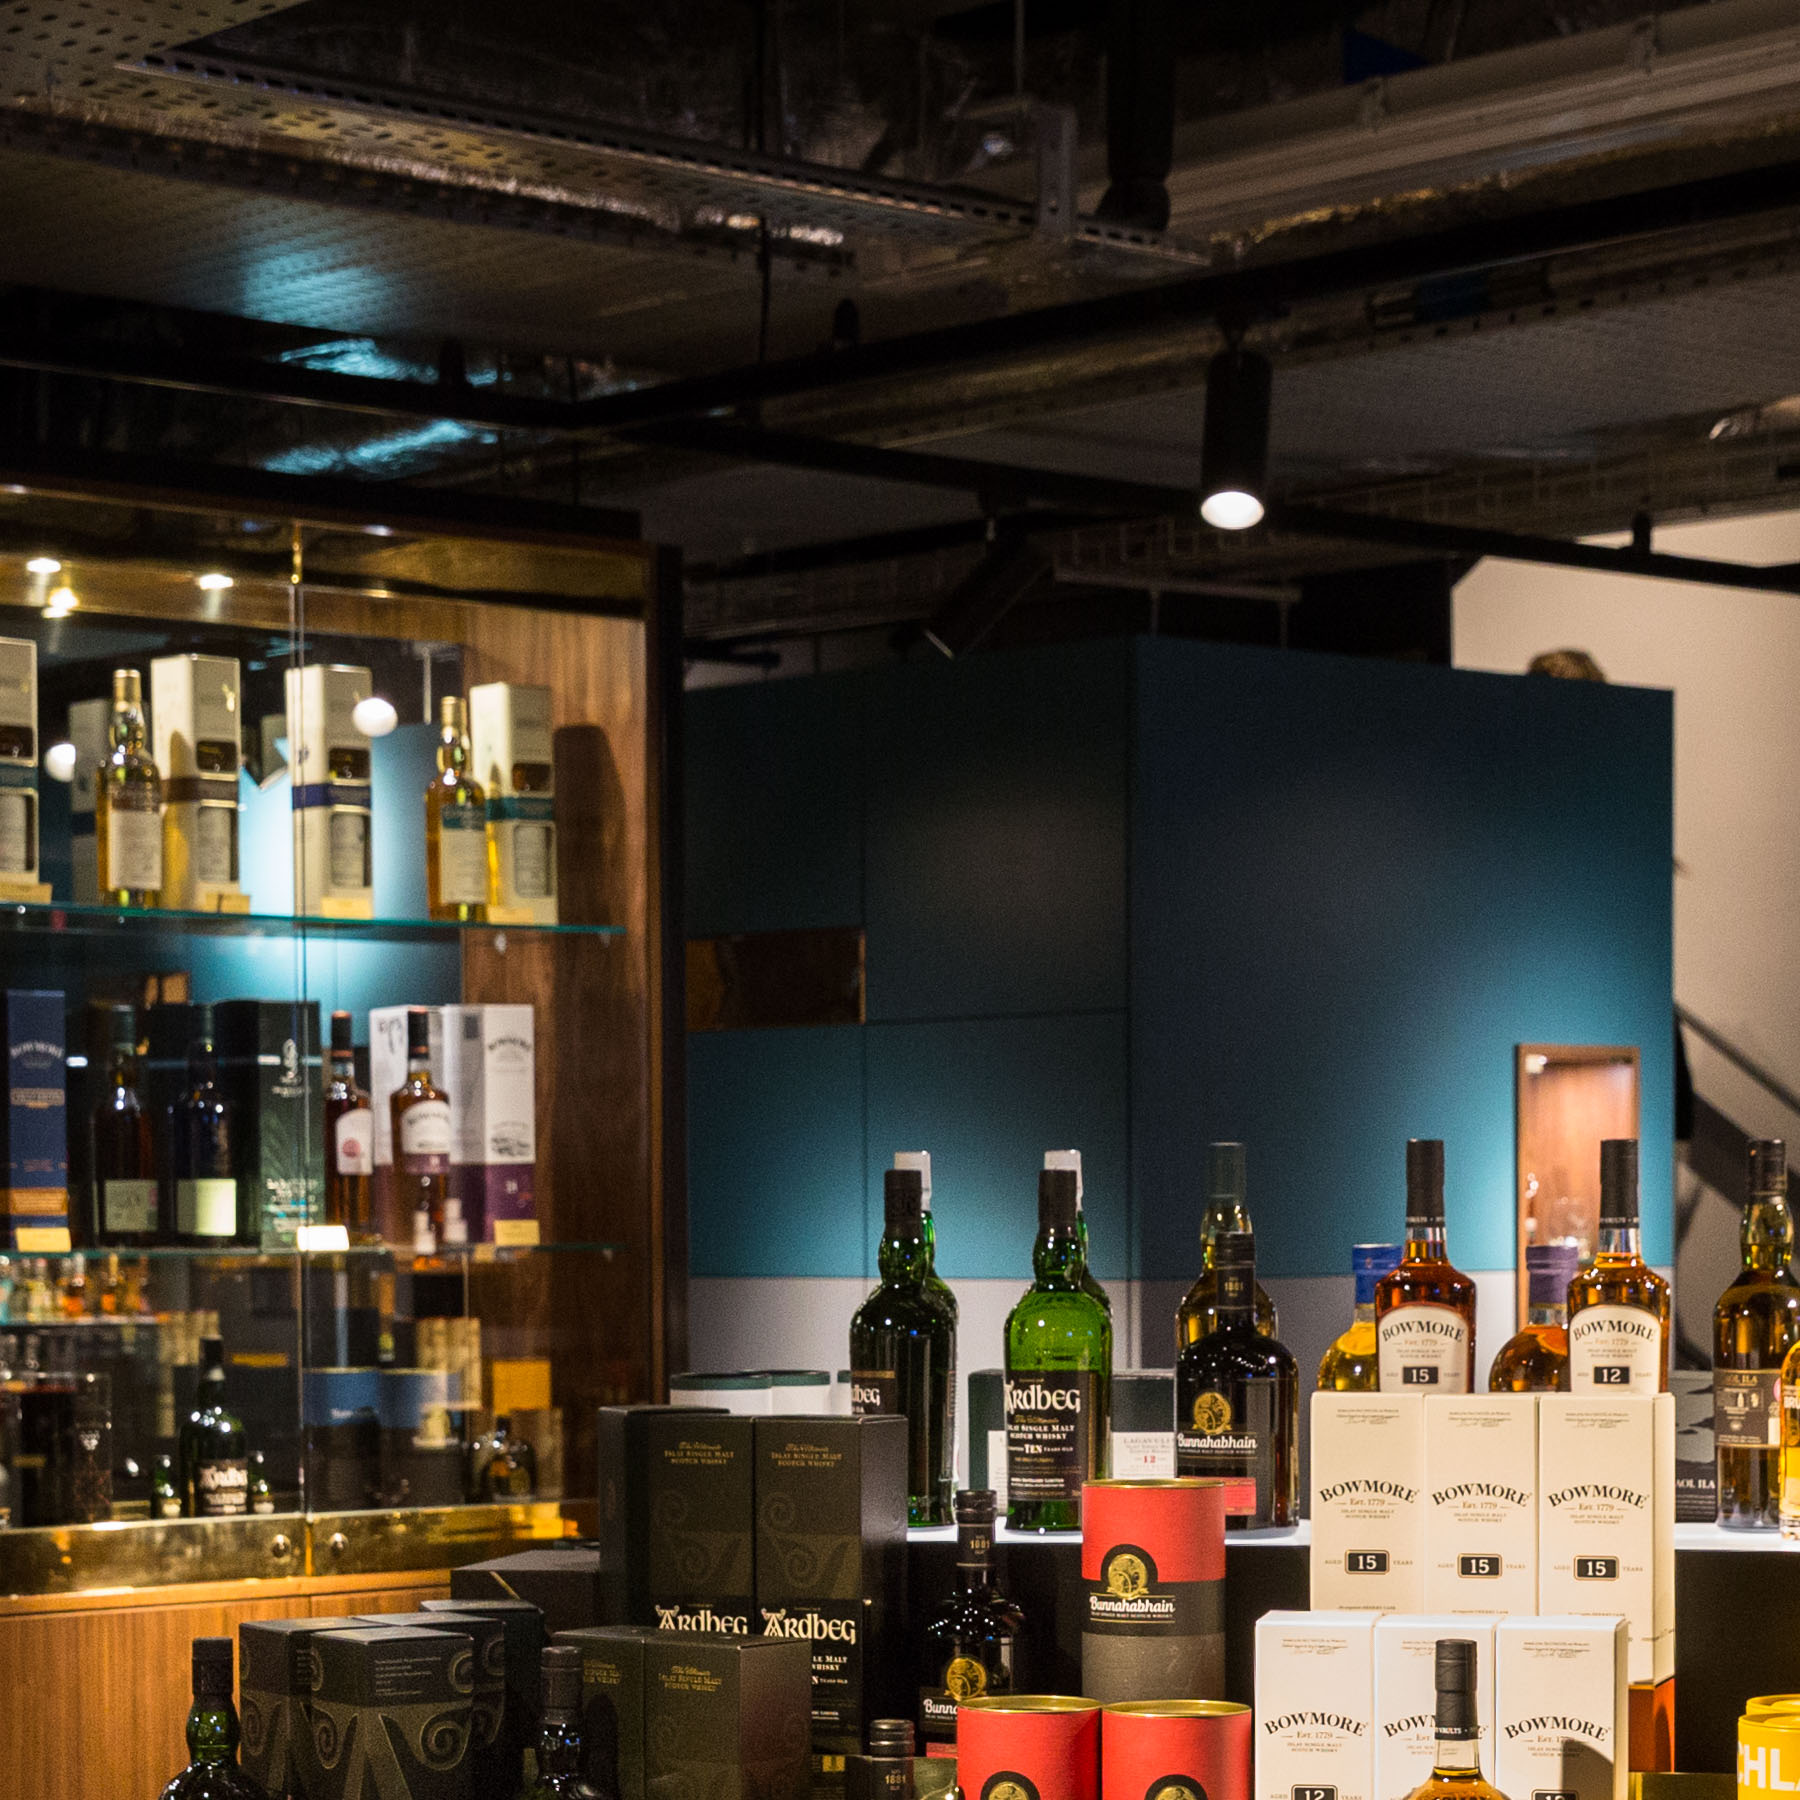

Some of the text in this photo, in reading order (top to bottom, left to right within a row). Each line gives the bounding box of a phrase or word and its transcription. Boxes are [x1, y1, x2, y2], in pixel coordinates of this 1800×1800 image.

[1382, 1320, 1464, 1343] BOWMORE
[1573, 1320, 1655, 1341] BOWMORE
[1411, 1368, 1430, 1383] 15
[1602, 1368, 1621, 1383] 12
[1021, 1423, 1076, 1432] SINGLE MALT
[1034, 1432, 1068, 1441] WHISKY
[1177, 1432, 1258, 1450] Bunnahabhain
[1024, 1443, 1043, 1454] TEN
[1319, 1479, 1418, 1504] BOWMORE
[1431, 1483, 1530, 1508] BOWMORE
[1547, 1484, 1646, 1509] BOWMORE
[1357, 1555, 1377, 1570] 15
[1470, 1559, 1490, 1574] 15
[1586, 1561, 1607, 1576] 15
[1088, 1595, 1176, 1614] Bunnahabhain
[825, 1655, 848, 1664] MALT
[1264, 1711, 1365, 1737] BOWMORE
[1504, 1715, 1609, 1742] BOWMORE
